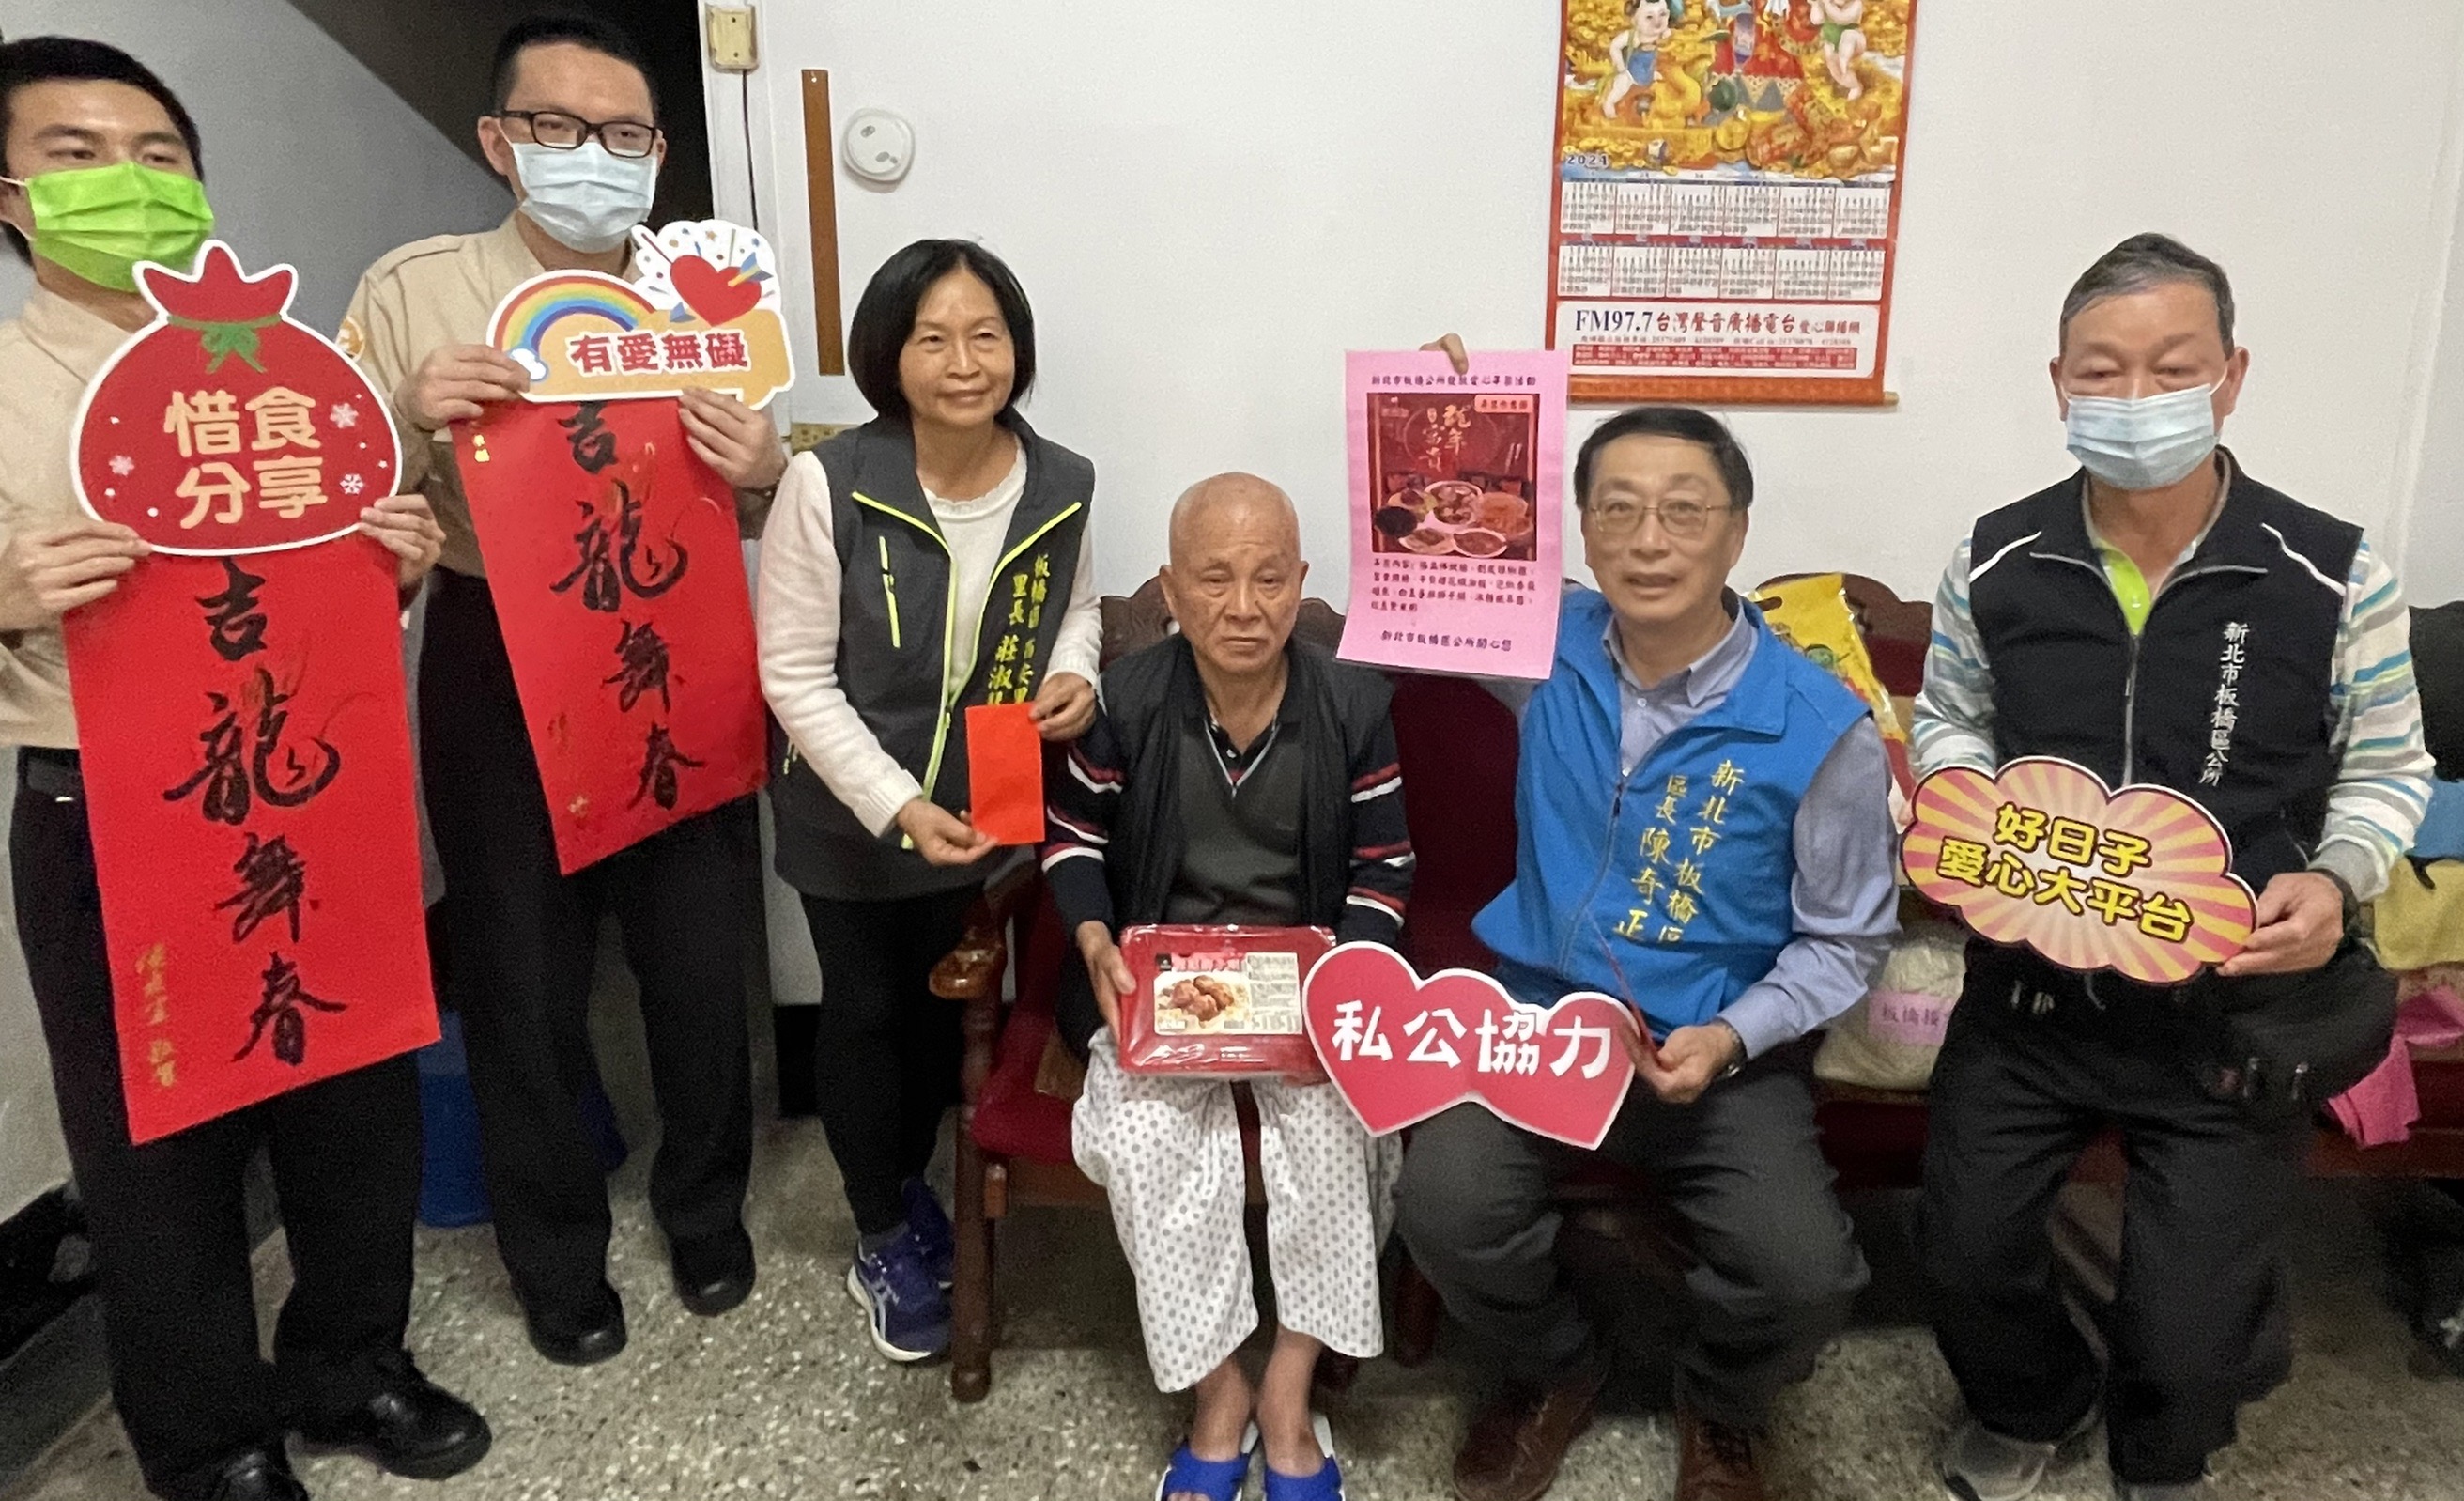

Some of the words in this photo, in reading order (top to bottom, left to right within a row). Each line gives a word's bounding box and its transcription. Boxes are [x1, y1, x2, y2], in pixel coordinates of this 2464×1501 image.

[1567, 155, 1608, 167] 2024
[1576, 309, 1653, 332] FM97.7
[1656, 311, 1795, 334] 台灣聲音廣播電台
[162, 386, 322, 458] 惜食
[175, 454, 328, 530] 分享
[2199, 621, 2250, 786] 新北市板橋區公所
[1612, 775, 1687, 936] 區長陳奇正
[1993, 801, 2153, 877] 好日子
[1936, 835, 2194, 944] 愛心大平台
[1332, 999, 1611, 1079] 私公協力
